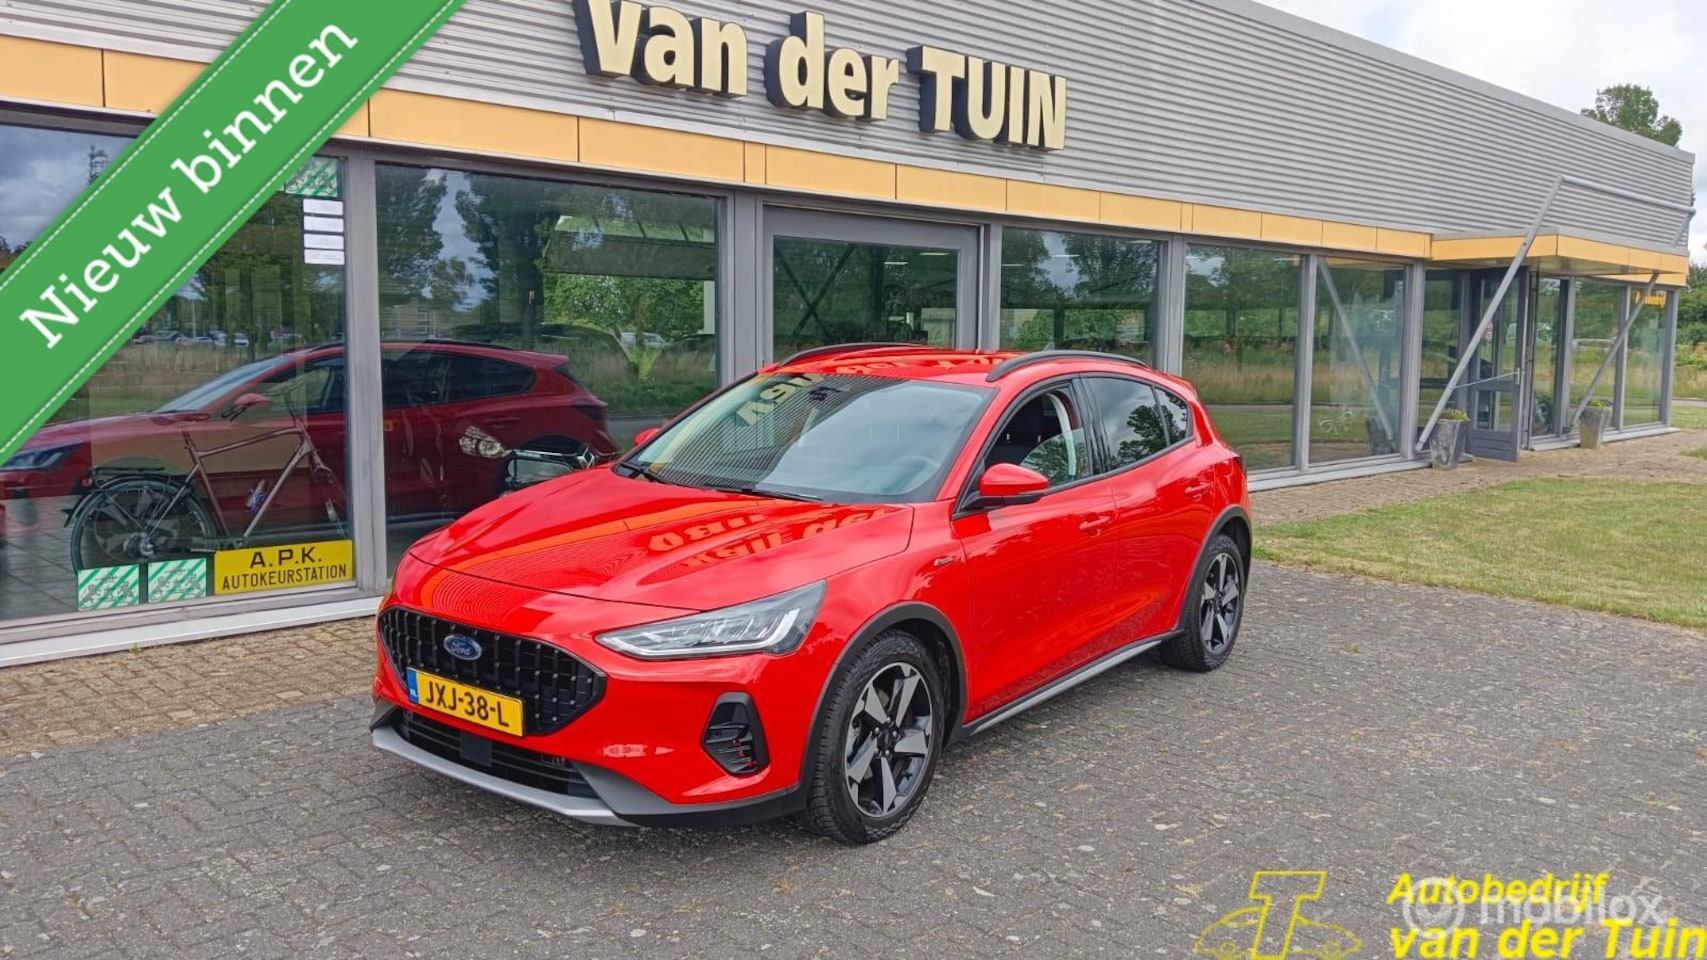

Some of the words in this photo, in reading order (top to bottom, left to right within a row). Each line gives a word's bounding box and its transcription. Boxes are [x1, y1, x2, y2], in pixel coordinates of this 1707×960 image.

[778, 11, 898, 121] der
[920, 45, 1068, 150] TUIN
[250, 546, 323, 569] A.P.K.
[222, 564, 347, 591] AUTOKEURSTATION
[450, 640, 471, 656] Ford
[426, 681, 510, 727] JXJ-38-L
